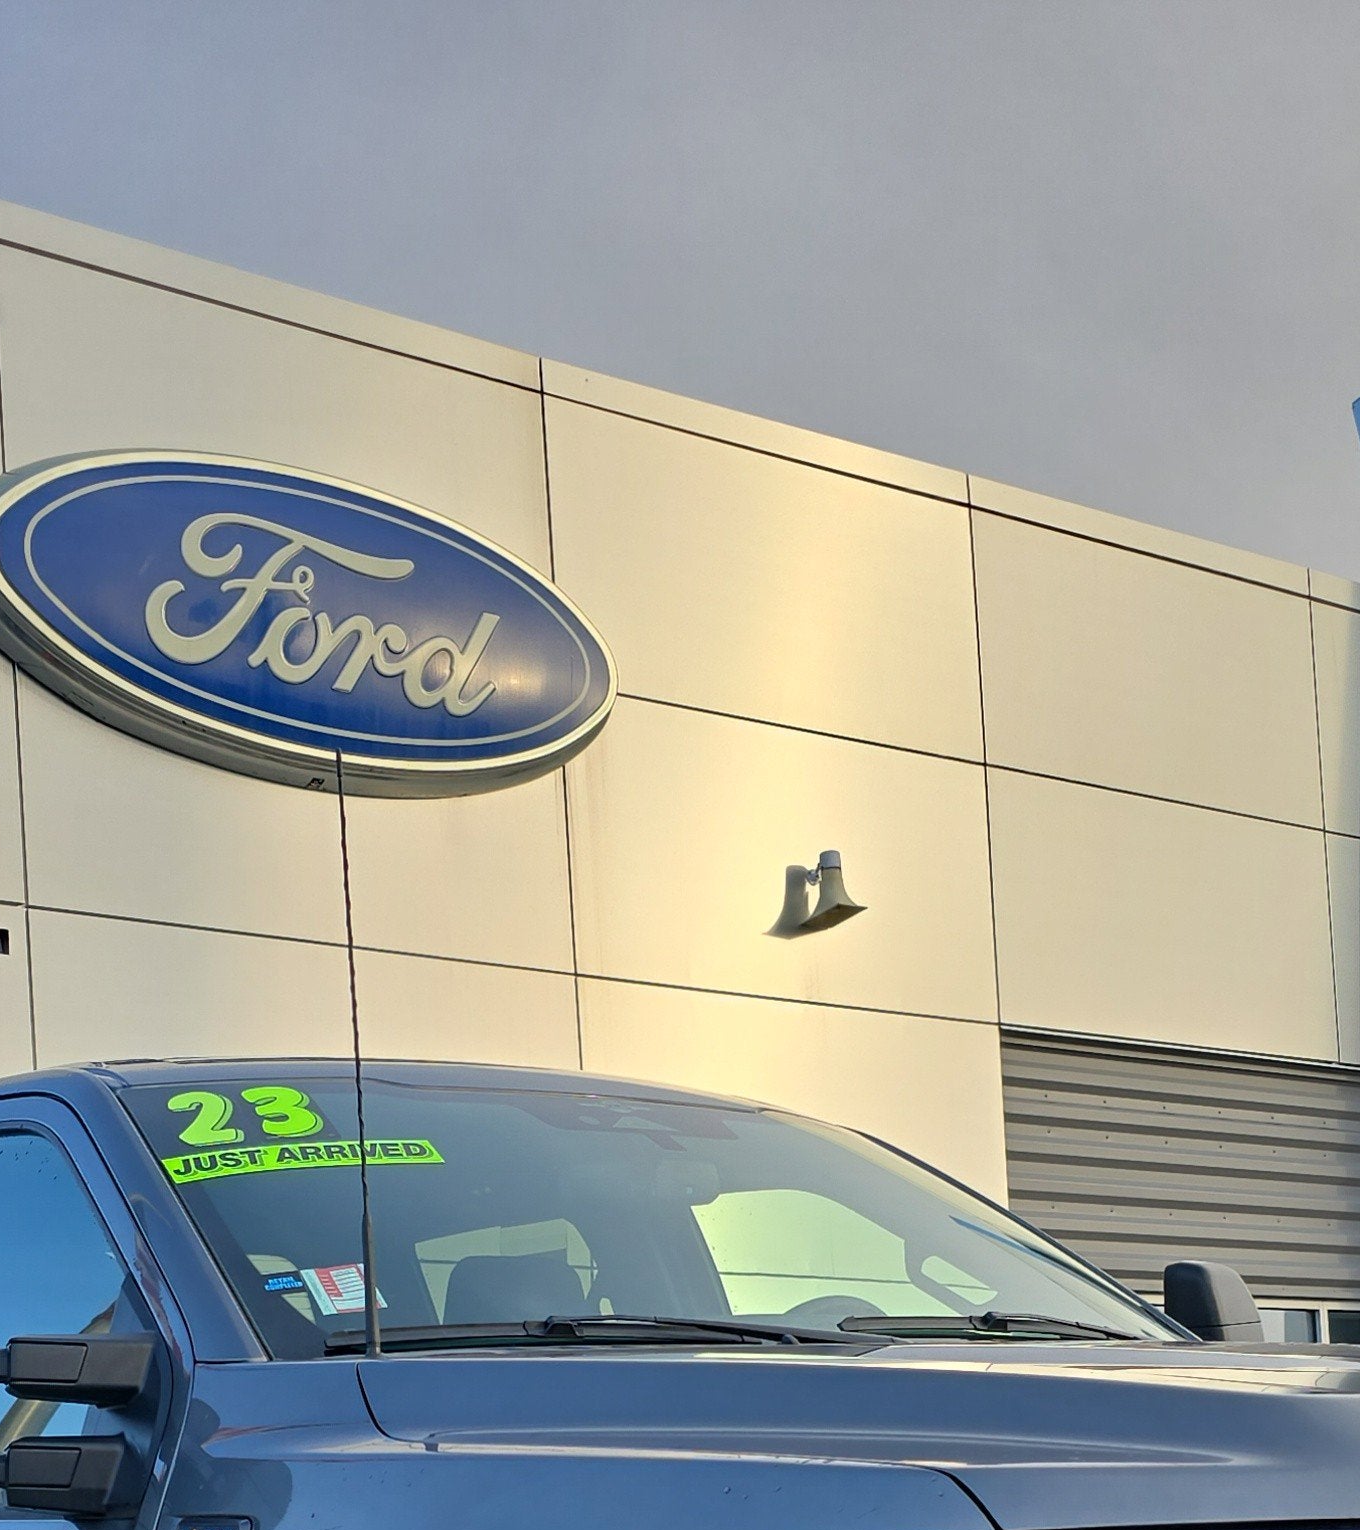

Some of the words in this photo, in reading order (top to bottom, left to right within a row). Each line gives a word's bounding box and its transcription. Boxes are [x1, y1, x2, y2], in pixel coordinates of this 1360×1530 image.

[145, 512, 500, 718] Ford
[167, 1086, 324, 1147] 23
[174, 1149, 267, 1177] JUST
[275, 1142, 435, 1165] ARRIVED
